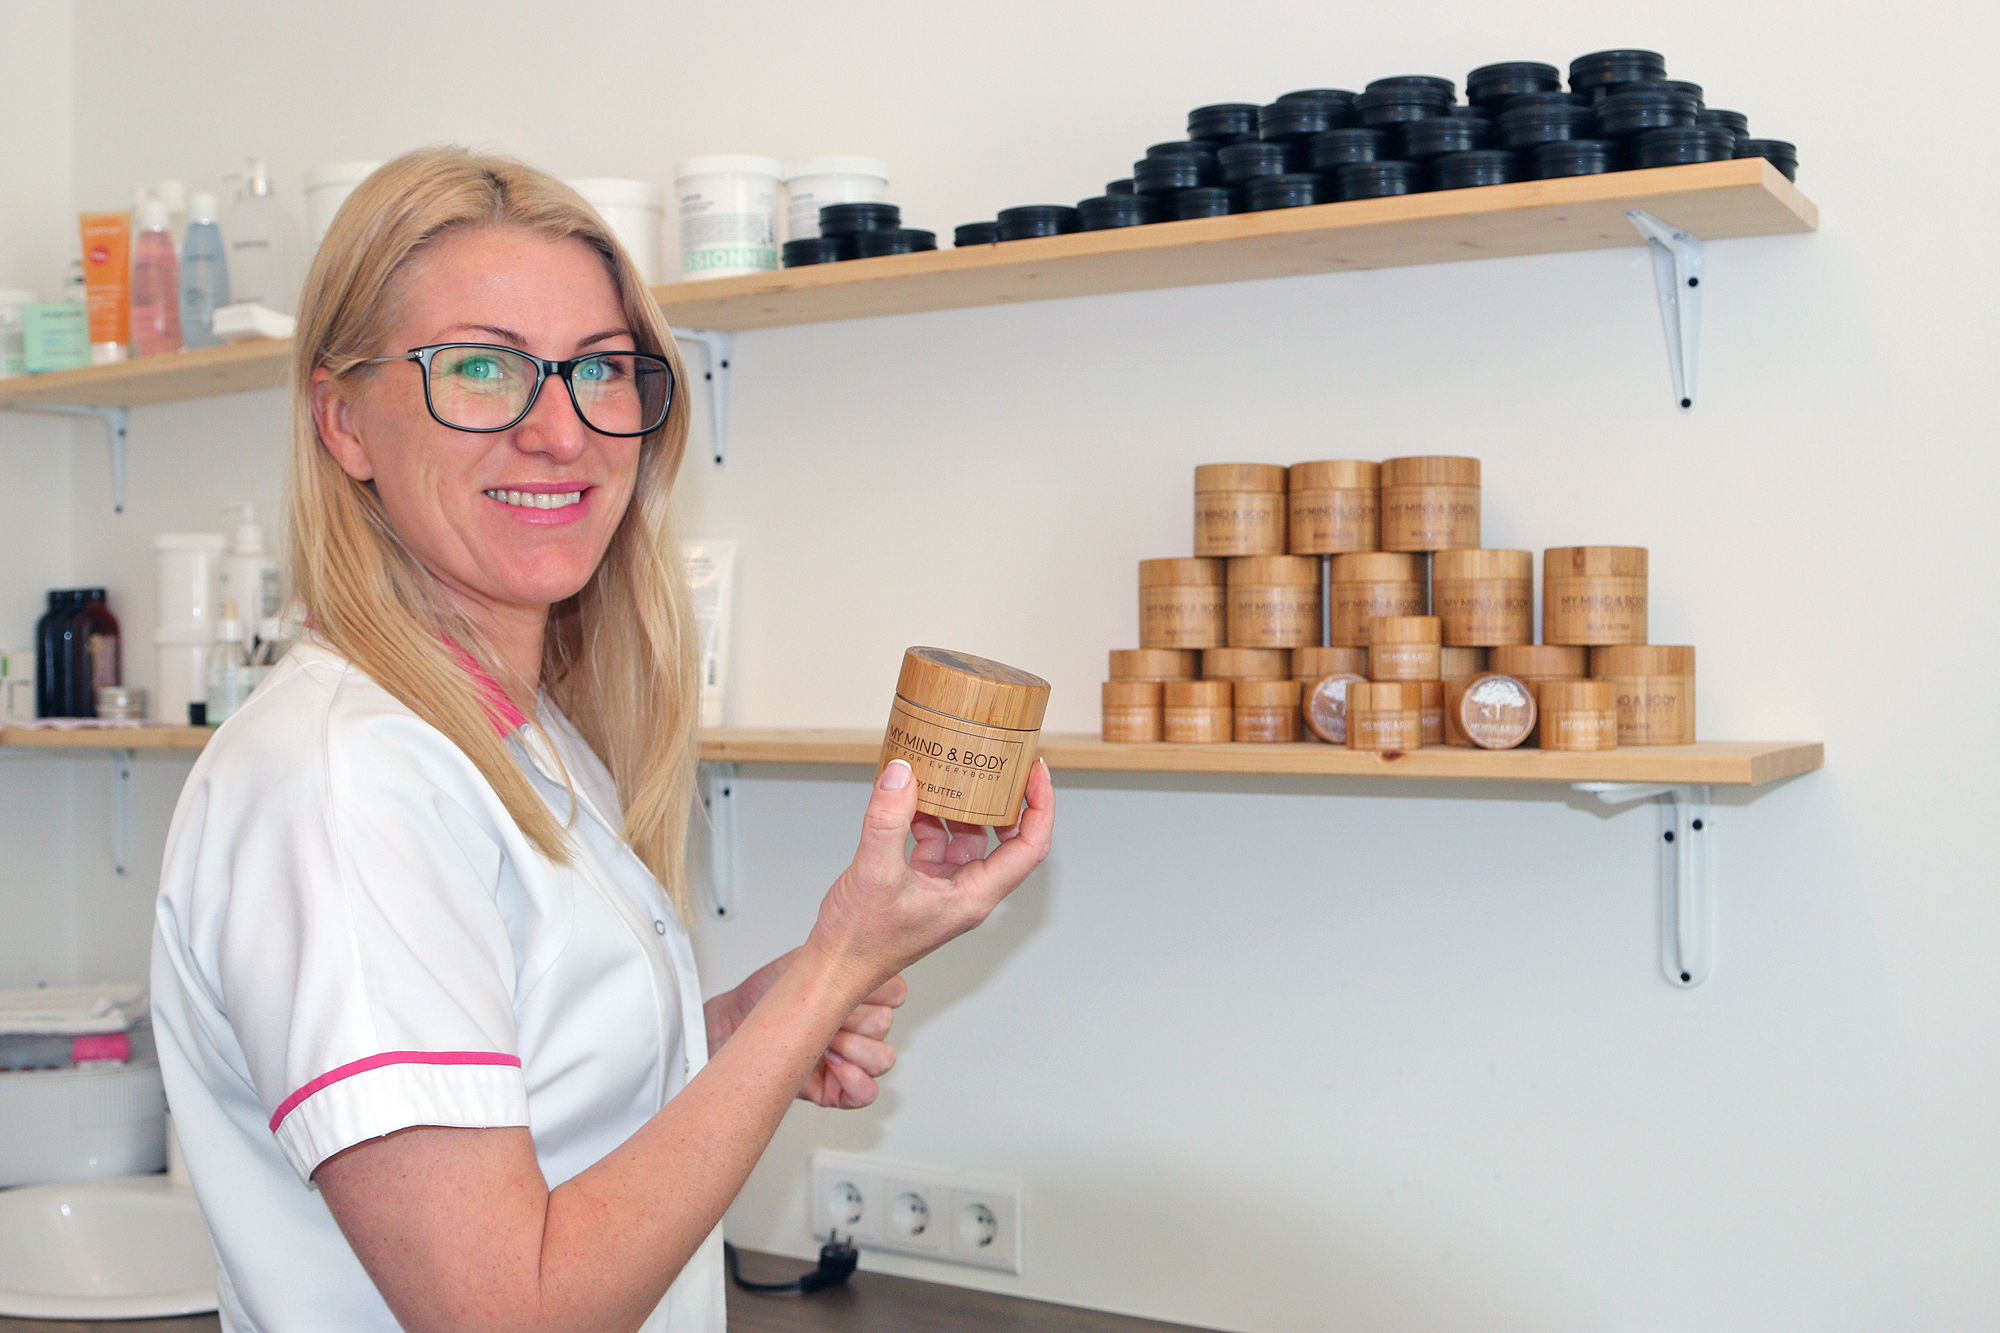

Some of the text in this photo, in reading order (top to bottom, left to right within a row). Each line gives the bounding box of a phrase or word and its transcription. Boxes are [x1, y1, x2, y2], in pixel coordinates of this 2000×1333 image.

[1205, 509, 1229, 520] MIND
[1307, 505, 1335, 517] MIND
[1390, 503, 1404, 513] MY
[1405, 503, 1435, 514] MIND
[1448, 503, 1475, 515] BODY
[1445, 598, 1460, 609] MY
[1462, 598, 1492, 610] MIND
[1561, 595, 1577, 606] MY
[1580, 595, 1612, 607] MIND
[1254, 602, 1285, 613] MIND
[1646, 693, 1678, 707] BODY
[889, 725, 1008, 771] MY MIND & BODY
[886, 742, 1002, 782] NOT FOR EVERYBODY
[927, 783, 963, 800] BUTTER
